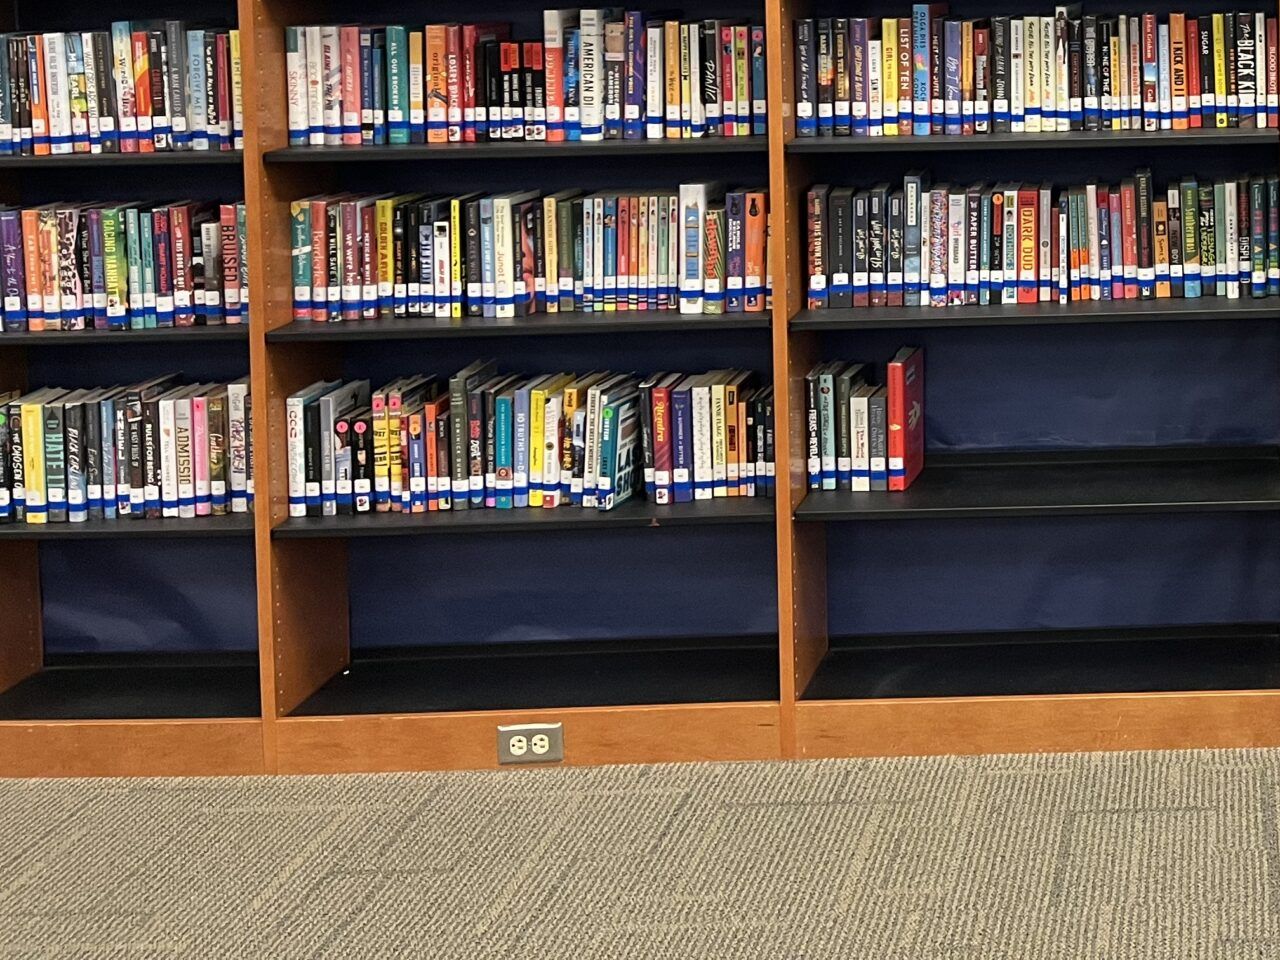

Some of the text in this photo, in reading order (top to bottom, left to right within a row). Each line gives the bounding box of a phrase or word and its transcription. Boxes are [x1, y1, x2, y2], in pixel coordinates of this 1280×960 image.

[900, 29, 909, 90] LIST OF TEN
[1173, 47, 1183, 65] KICK
[1237, 24, 1255, 76] The BLACK
[1269, 47, 1277, 70] BLOOD
[448, 55, 457, 83] LOSERS
[583, 42, 594, 92] AMERICAN
[705, 60, 718, 100] PANIC
[1103, 67, 1110, 76] OF
[1174, 69, 1184, 85] AND
[70, 75, 79, 99] EARL
[171, 74, 180, 113] MAN CALLED
[192, 54, 201, 109] FORGIVE ME
[289, 71, 298, 106] SKINNY
[996, 79, 1005, 99] JOHN
[103, 220, 115, 252] RACING
[379, 222, 388, 251] GOLDEN
[951, 222, 961, 237] girl
[970, 212, 978, 236] PAPER
[1022, 209, 1033, 241] DARK
[221, 225, 237, 282] BRUISED
[345, 233, 354, 270] we were
[814, 237, 822, 257] TOWN
[1006, 225, 1014, 262] NOTHING
[497, 251, 505, 277] Junot
[517, 413, 525, 421] 10
[808, 409, 817, 431] FREAKS
[68, 428, 79, 452] BLACK
[145, 423, 153, 446] RULES
[210, 433, 222, 463] Gather
[12, 445, 23, 479] CHOSEN
[45, 433, 64, 468] HATE
[146, 462, 154, 482] BEING
